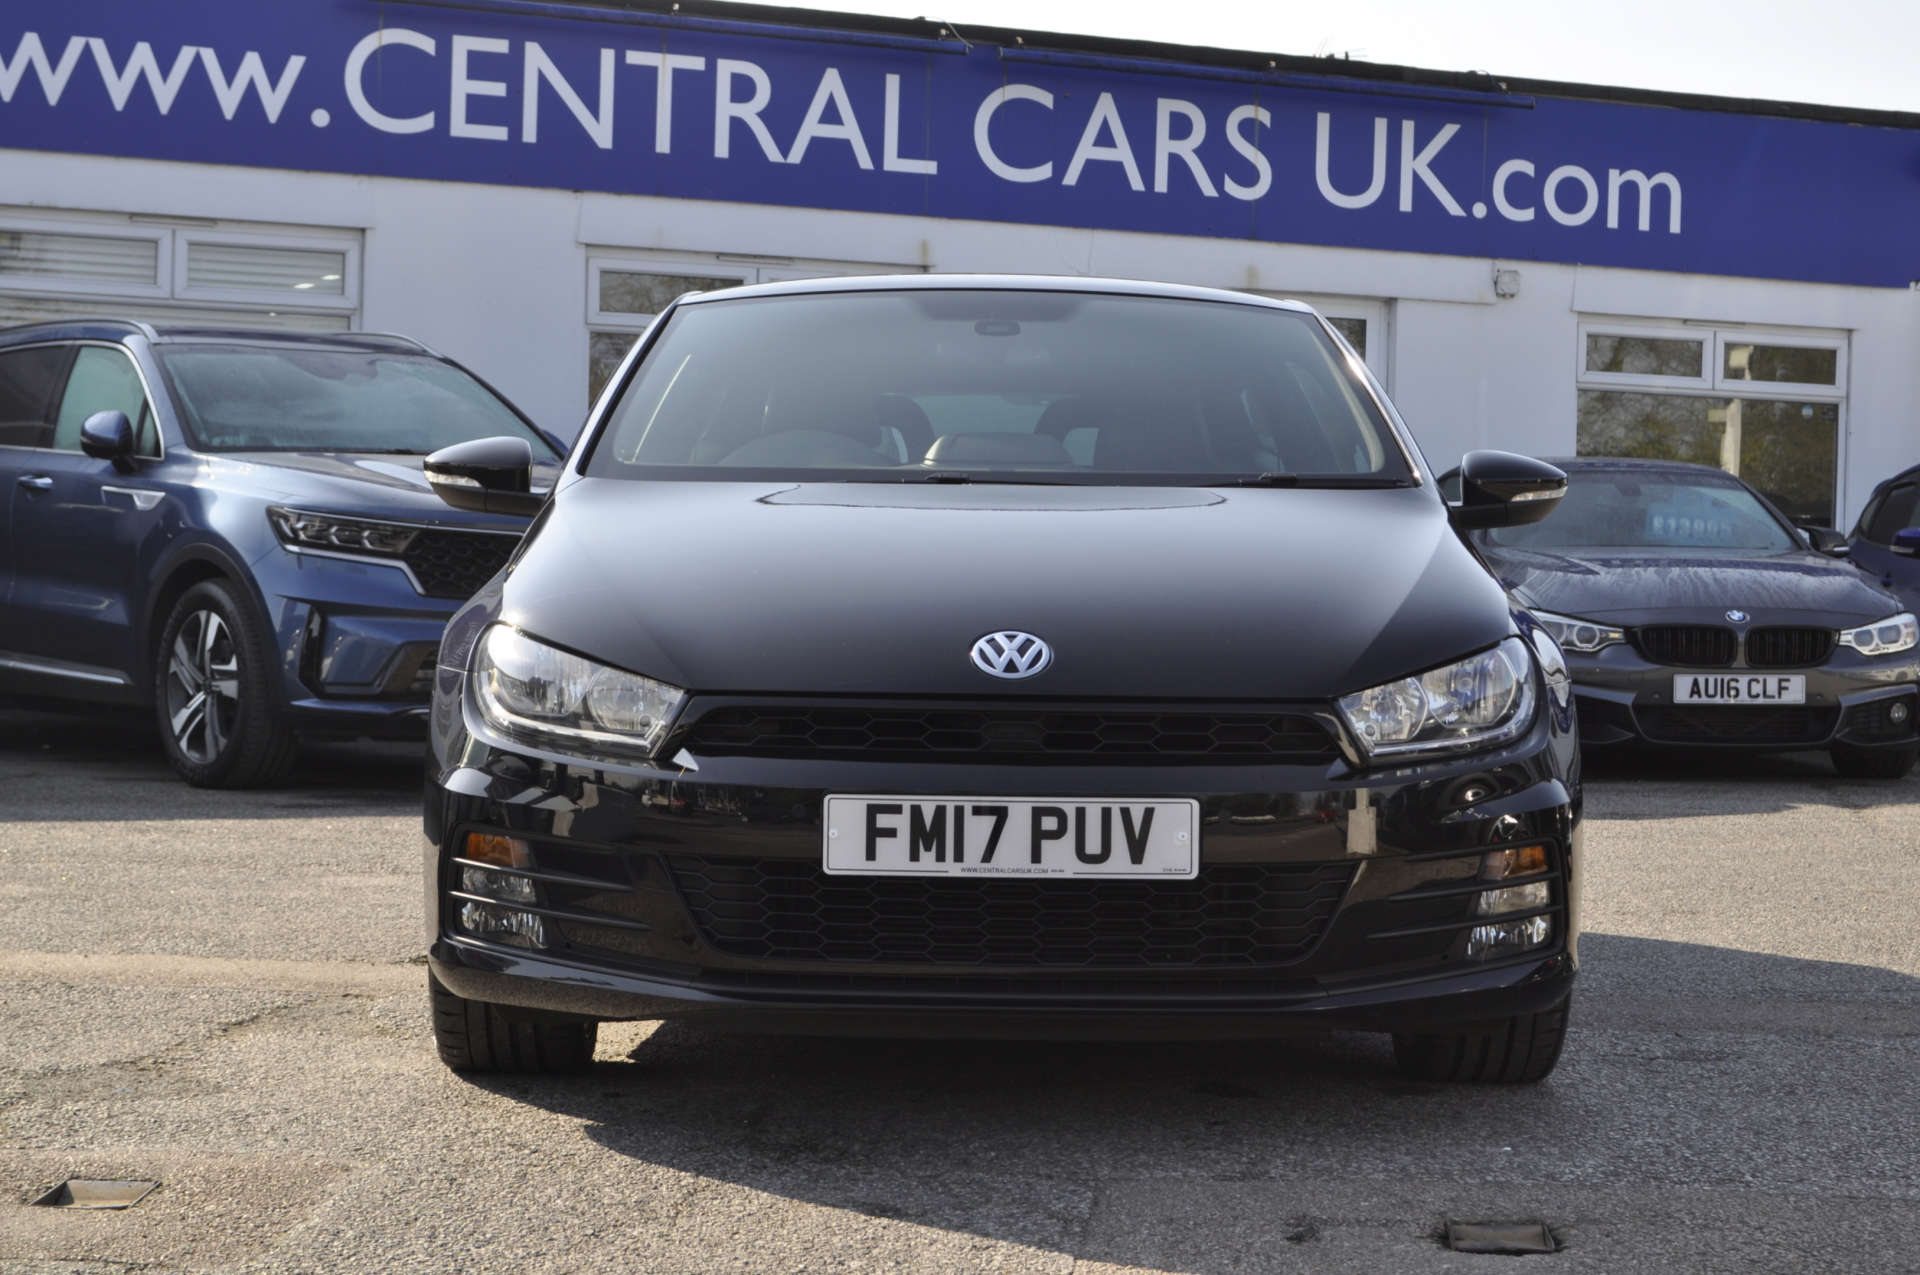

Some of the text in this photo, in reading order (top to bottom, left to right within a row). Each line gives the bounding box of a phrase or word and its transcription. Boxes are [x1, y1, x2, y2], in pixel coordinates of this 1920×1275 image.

[968, 83, 1274, 202] CARS
[1315, 111, 1682, 235] UK.com
[1688, 677, 1792, 700] AU16 CLF
[865, 803, 1156, 865] FM17 PUV
